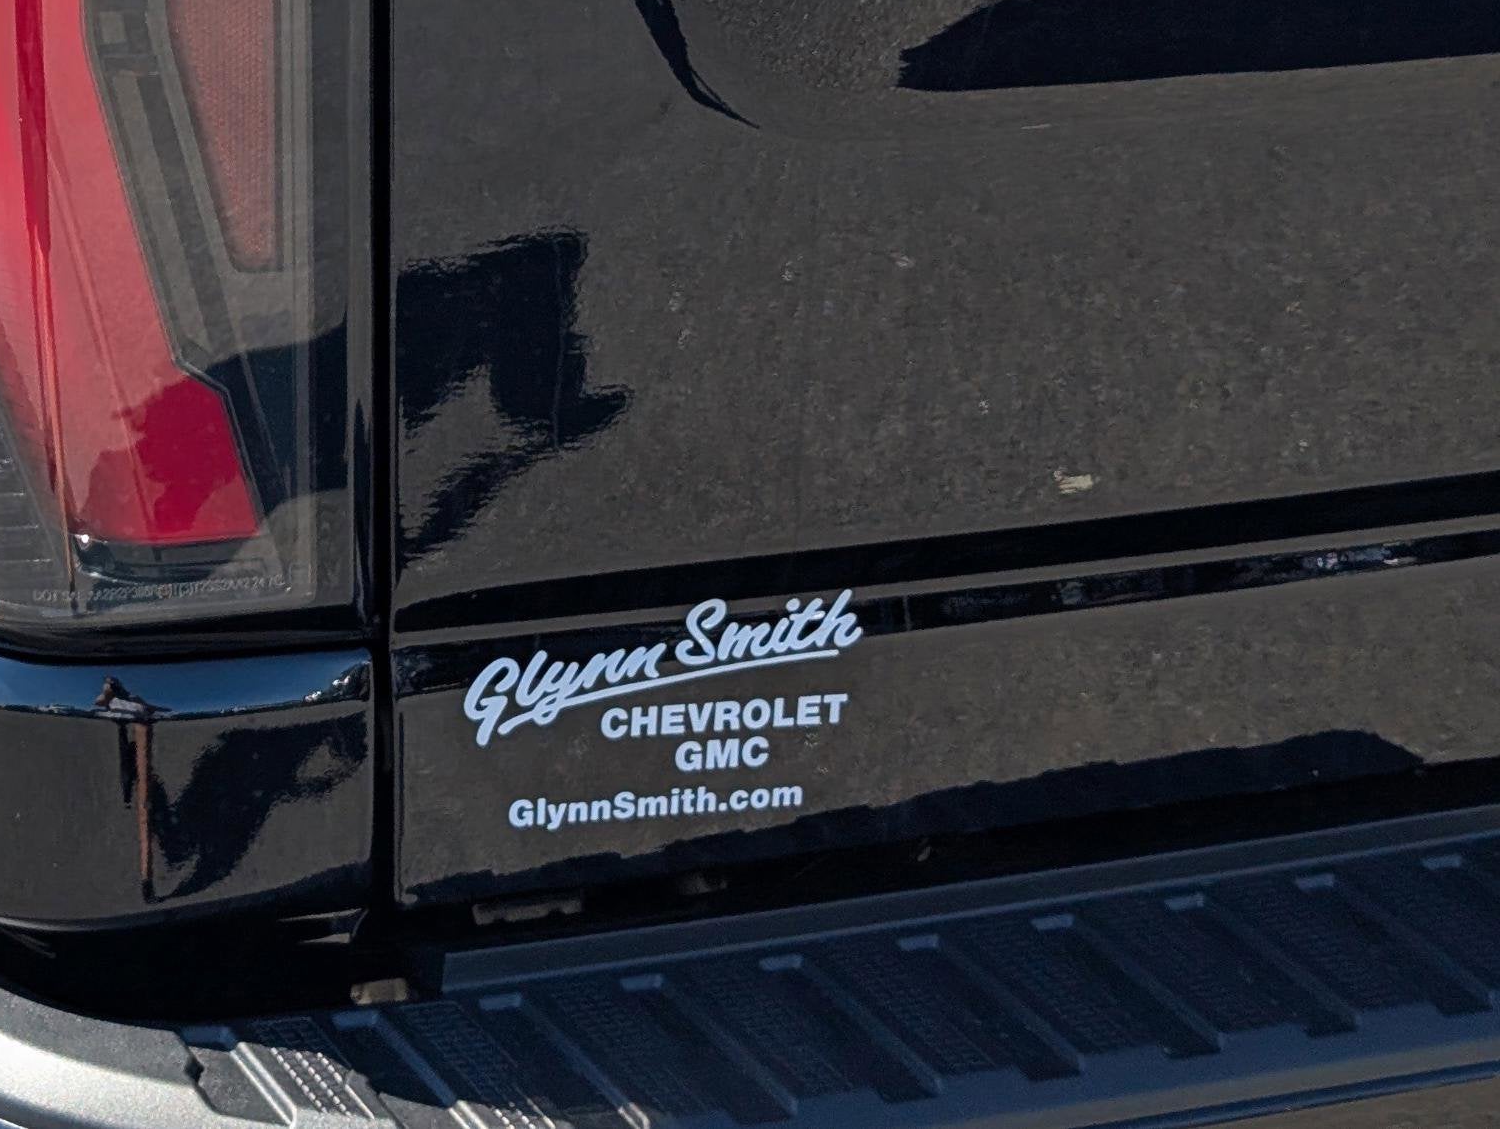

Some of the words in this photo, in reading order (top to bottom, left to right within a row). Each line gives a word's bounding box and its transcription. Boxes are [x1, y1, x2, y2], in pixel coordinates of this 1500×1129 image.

[463, 641, 669, 746] Glynn
[675, 588, 864, 666] Smith
[600, 693, 849, 739] CHEVROLET
[675, 736, 770, 771] GMC
[508, 783, 804, 831] GlynnSmith.com
